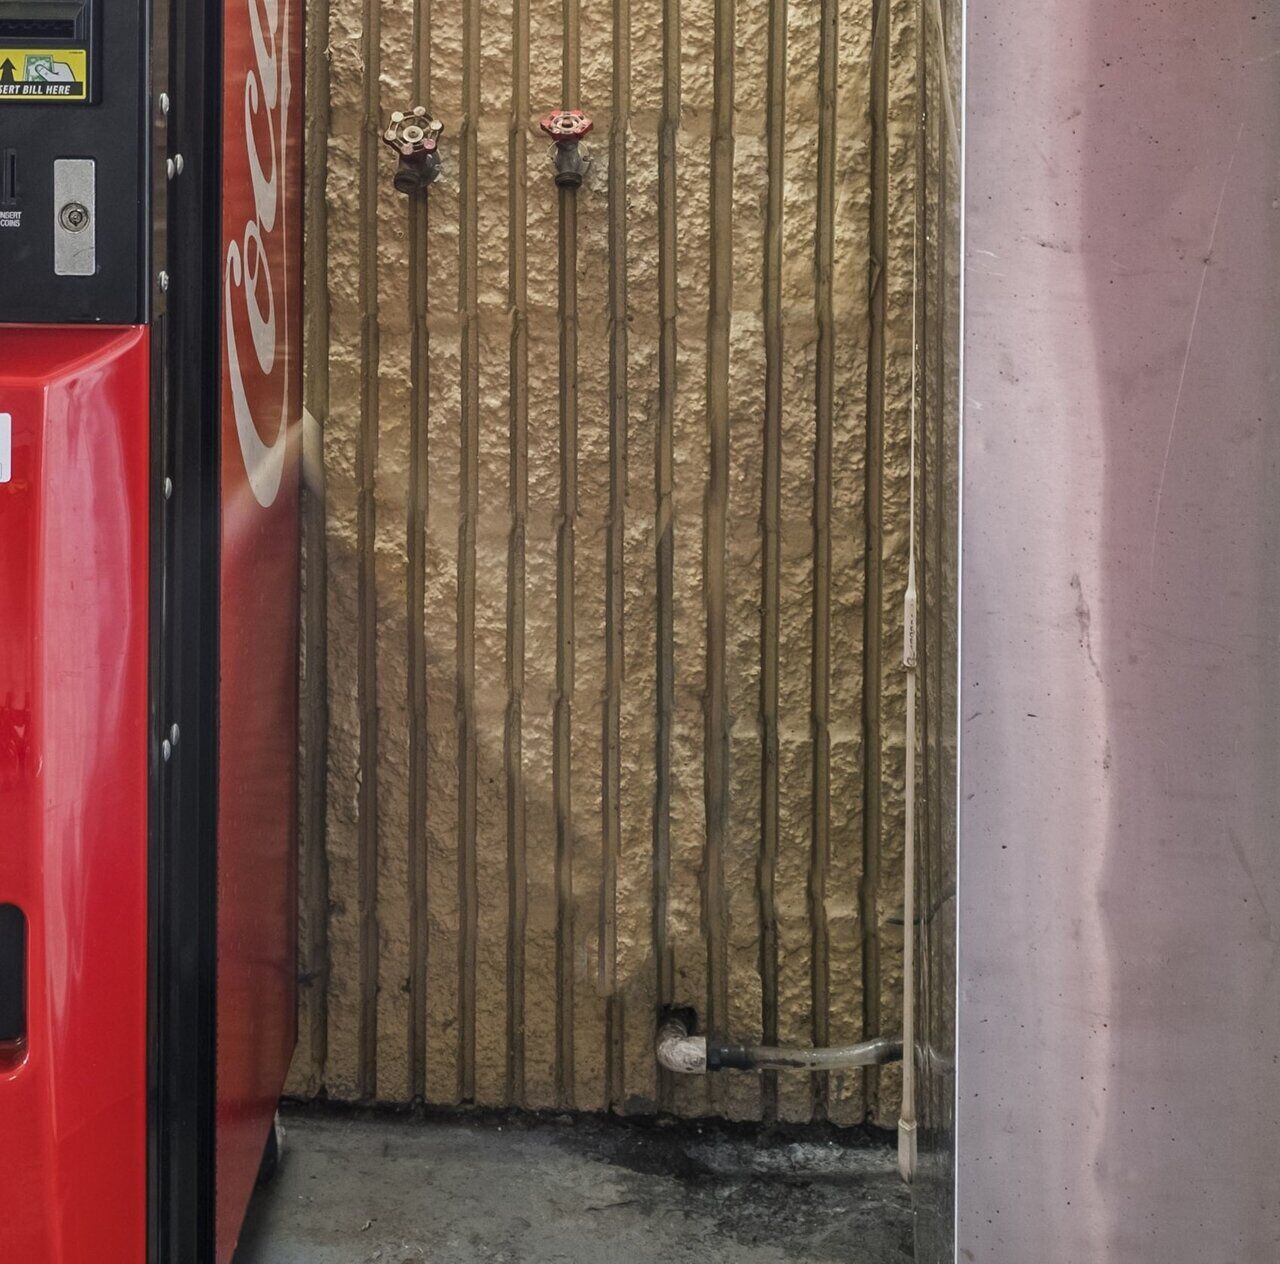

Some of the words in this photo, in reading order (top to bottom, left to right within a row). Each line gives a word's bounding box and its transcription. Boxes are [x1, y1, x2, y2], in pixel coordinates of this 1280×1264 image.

[22, 85, 43, 95] BILL
[46, 85, 71, 95] HERE
[0, 219, 20, 227] COINS
